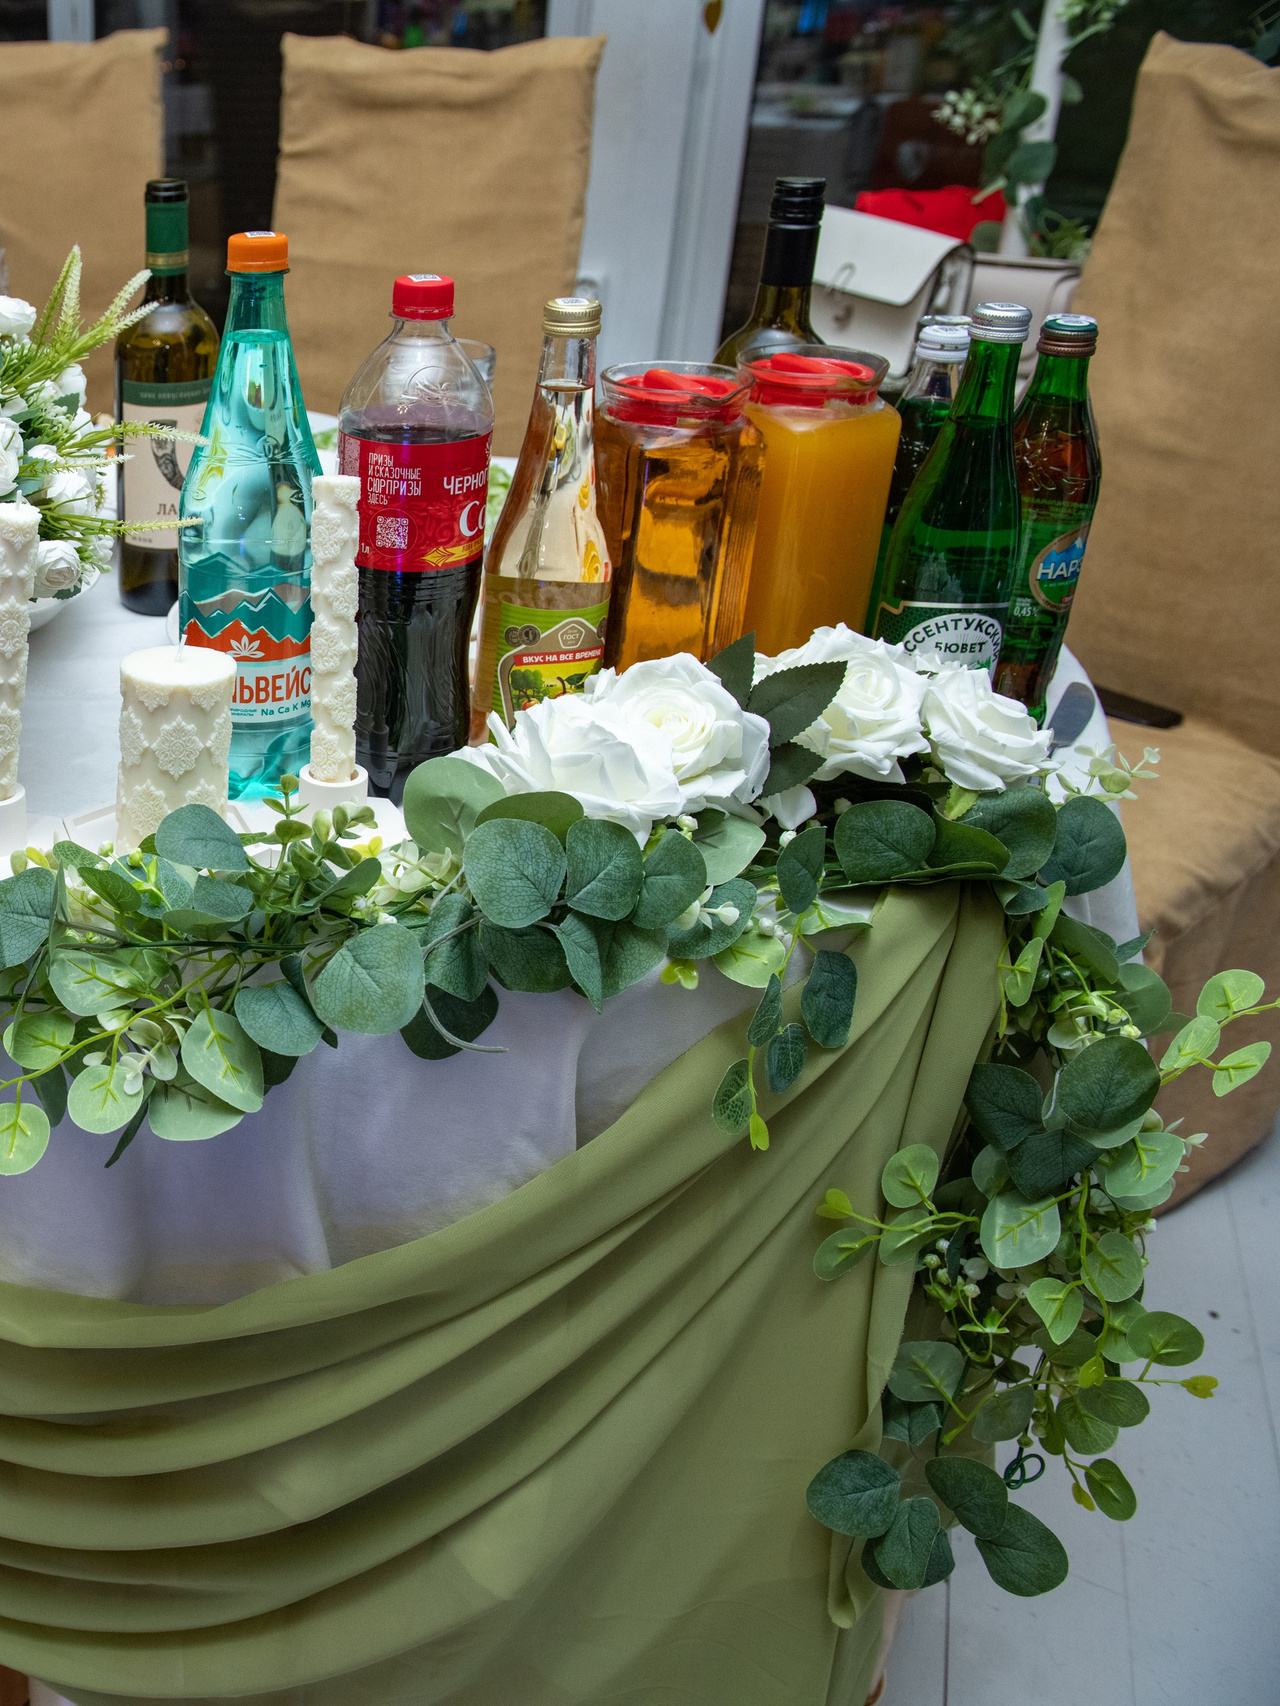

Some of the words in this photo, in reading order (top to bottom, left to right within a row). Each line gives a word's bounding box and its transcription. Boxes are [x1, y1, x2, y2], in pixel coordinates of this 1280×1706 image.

[368, 453, 394, 467] ПРИЗЫ
[368, 465, 374, 476] И
[374, 466, 422, 480] СКАЗОЧНЫЕ
[367, 477, 422, 496] СЮРПРИЗЫ
[443, 467, 489, 495] ЧЕРНОГ
[1014, 606, 1032, 617] 0,45
[904, 617, 1001, 662] ССЕНТУКСКИЙ
[522, 655, 544, 663] ВКУС
[545, 653, 558, 662] НА
[559, 653, 574, 661] ВСЕ
[261, 708, 274, 716] Na
[277, 706, 290, 714] Ca
[292, 702, 299, 711] K
[300, 700, 312, 708] Mg
